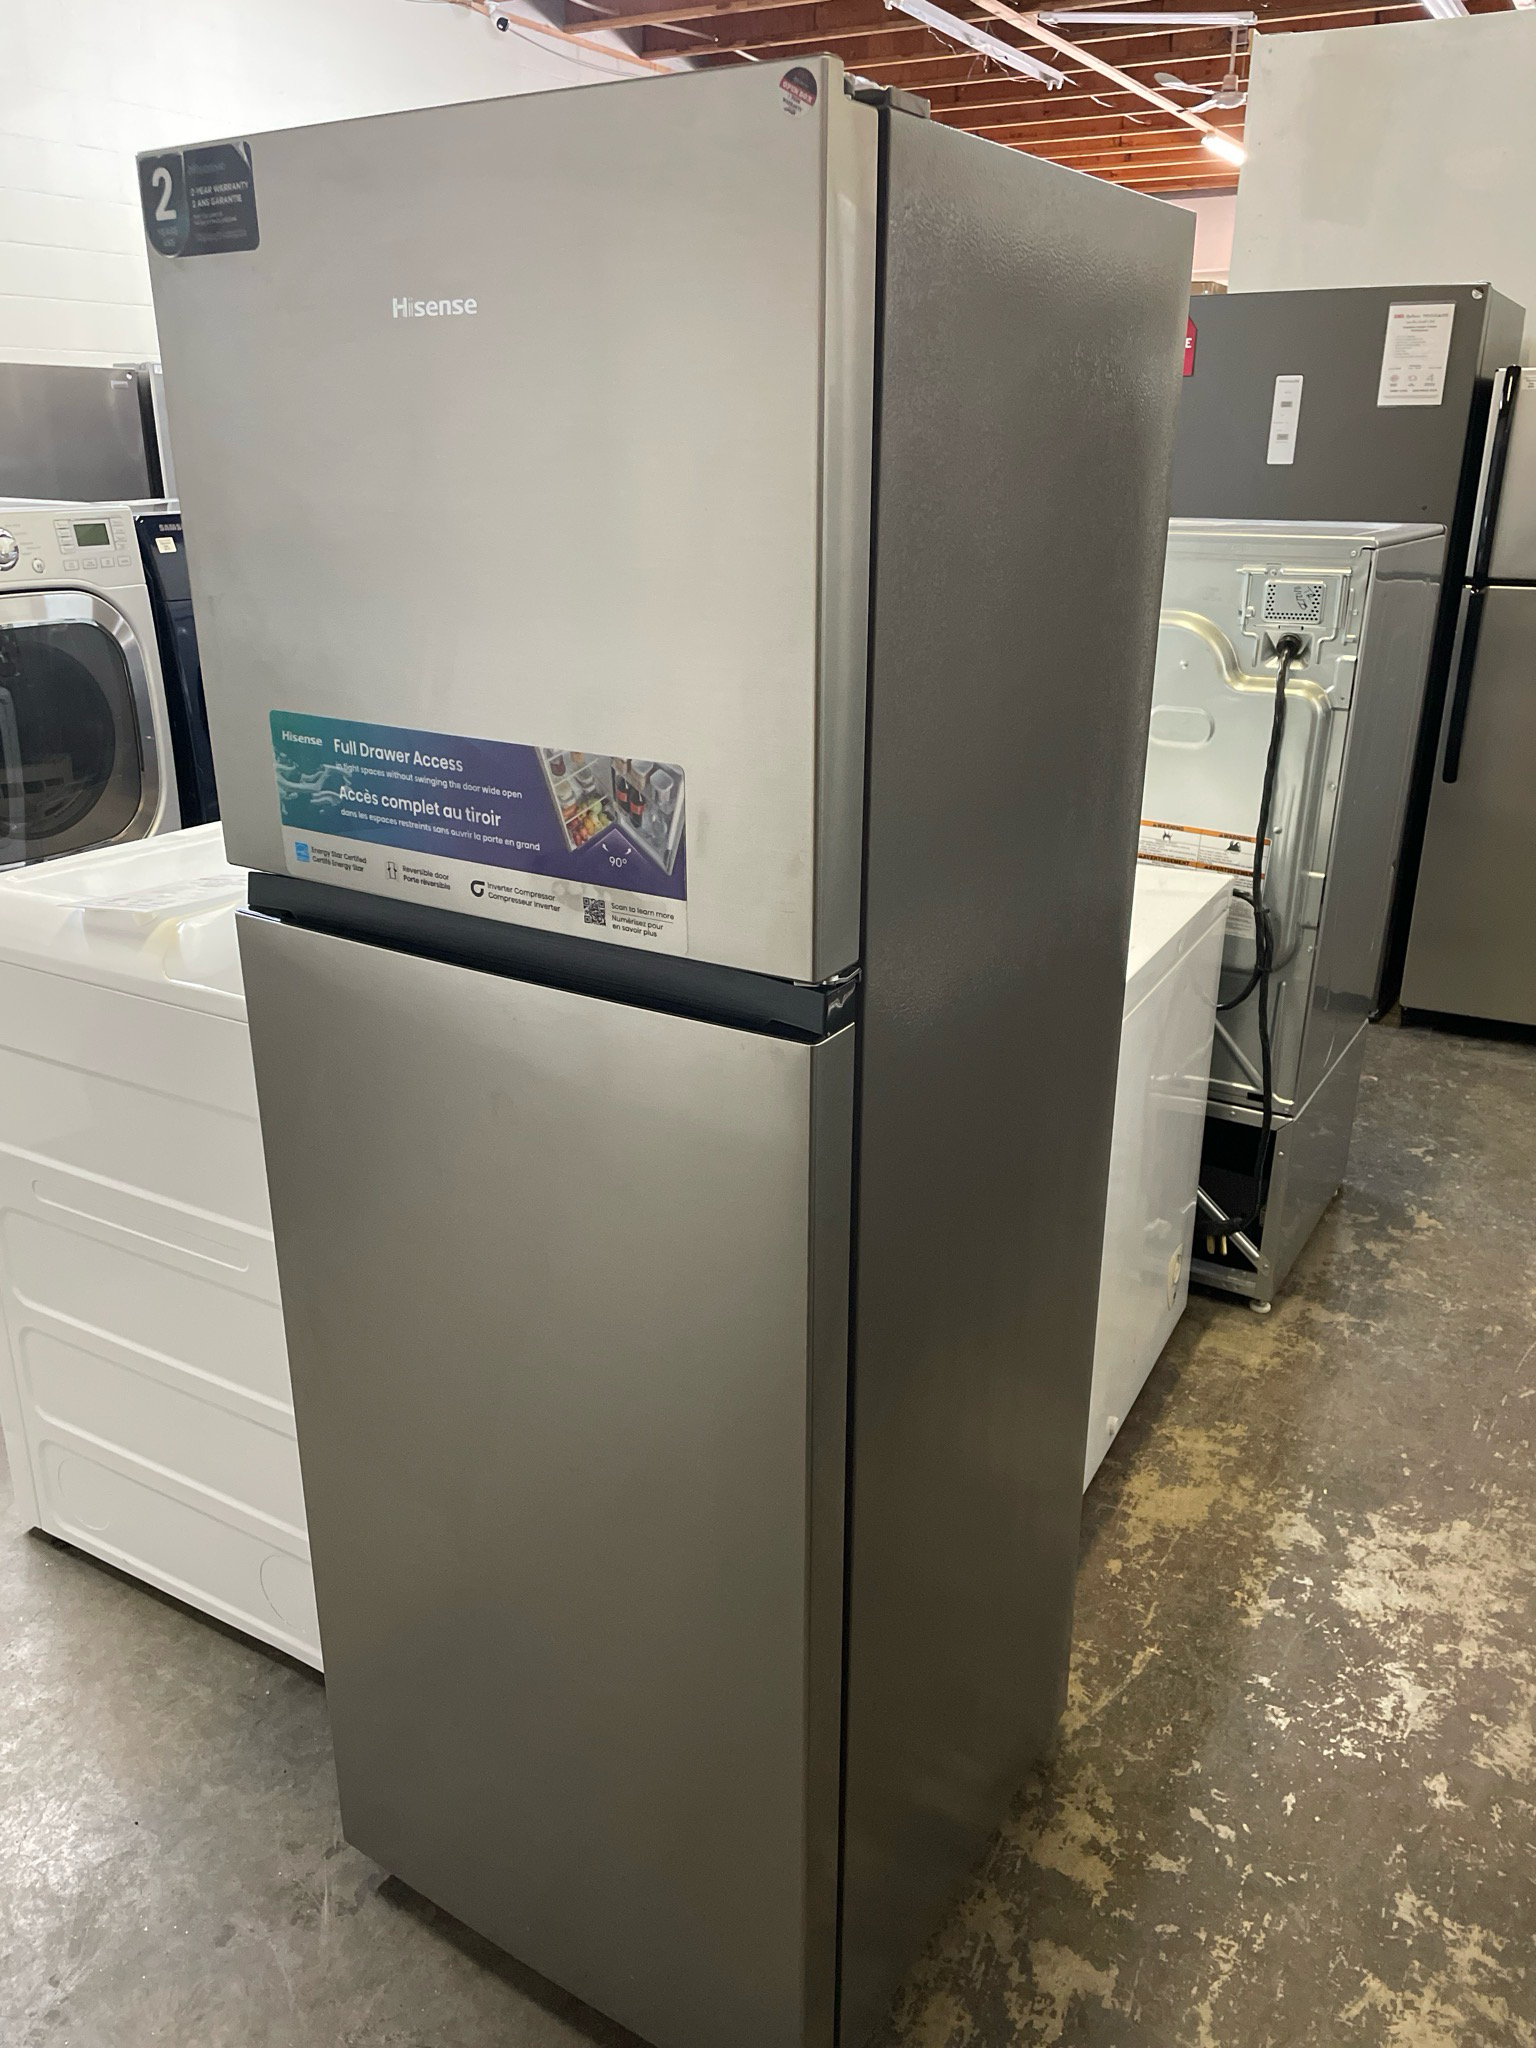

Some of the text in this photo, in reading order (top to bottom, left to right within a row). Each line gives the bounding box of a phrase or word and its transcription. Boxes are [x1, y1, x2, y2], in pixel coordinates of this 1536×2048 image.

[152, 167, 177, 221] 2
[392, 297, 478, 318] Hisense
[281, 730, 323, 746] Hisense
[333, 738, 464, 773] Full Drawer Access
[360, 766, 385, 777] spaces
[386, 770, 414, 782] without
[414, 775, 448, 789] swinging
[448, 780, 462, 790] the
[462, 782, 481, 792] door
[481, 785, 501, 795] wide
[501, 789, 523, 800] open
[339, 785, 502, 827] Accès complet au tiroir
[340, 808, 541, 851] dans les espaces restreints sans ouvrir la porte en grand
[608, 856, 628, 868] 90°
[402, 865, 450, 881] Reversible door
[403, 874, 420, 884] Porte
[487, 881, 556, 901] Inverter Compressor
[487, 891, 561, 912] Compresseur Inverter
[611, 902, 628, 911] Scan
[637, 907, 655, 916] learn
[655, 912, 675, 920] more
[611, 914, 664, 931] Numérisez pour
[622, 924, 642, 934] savoir
[643, 928, 658, 938] plus
